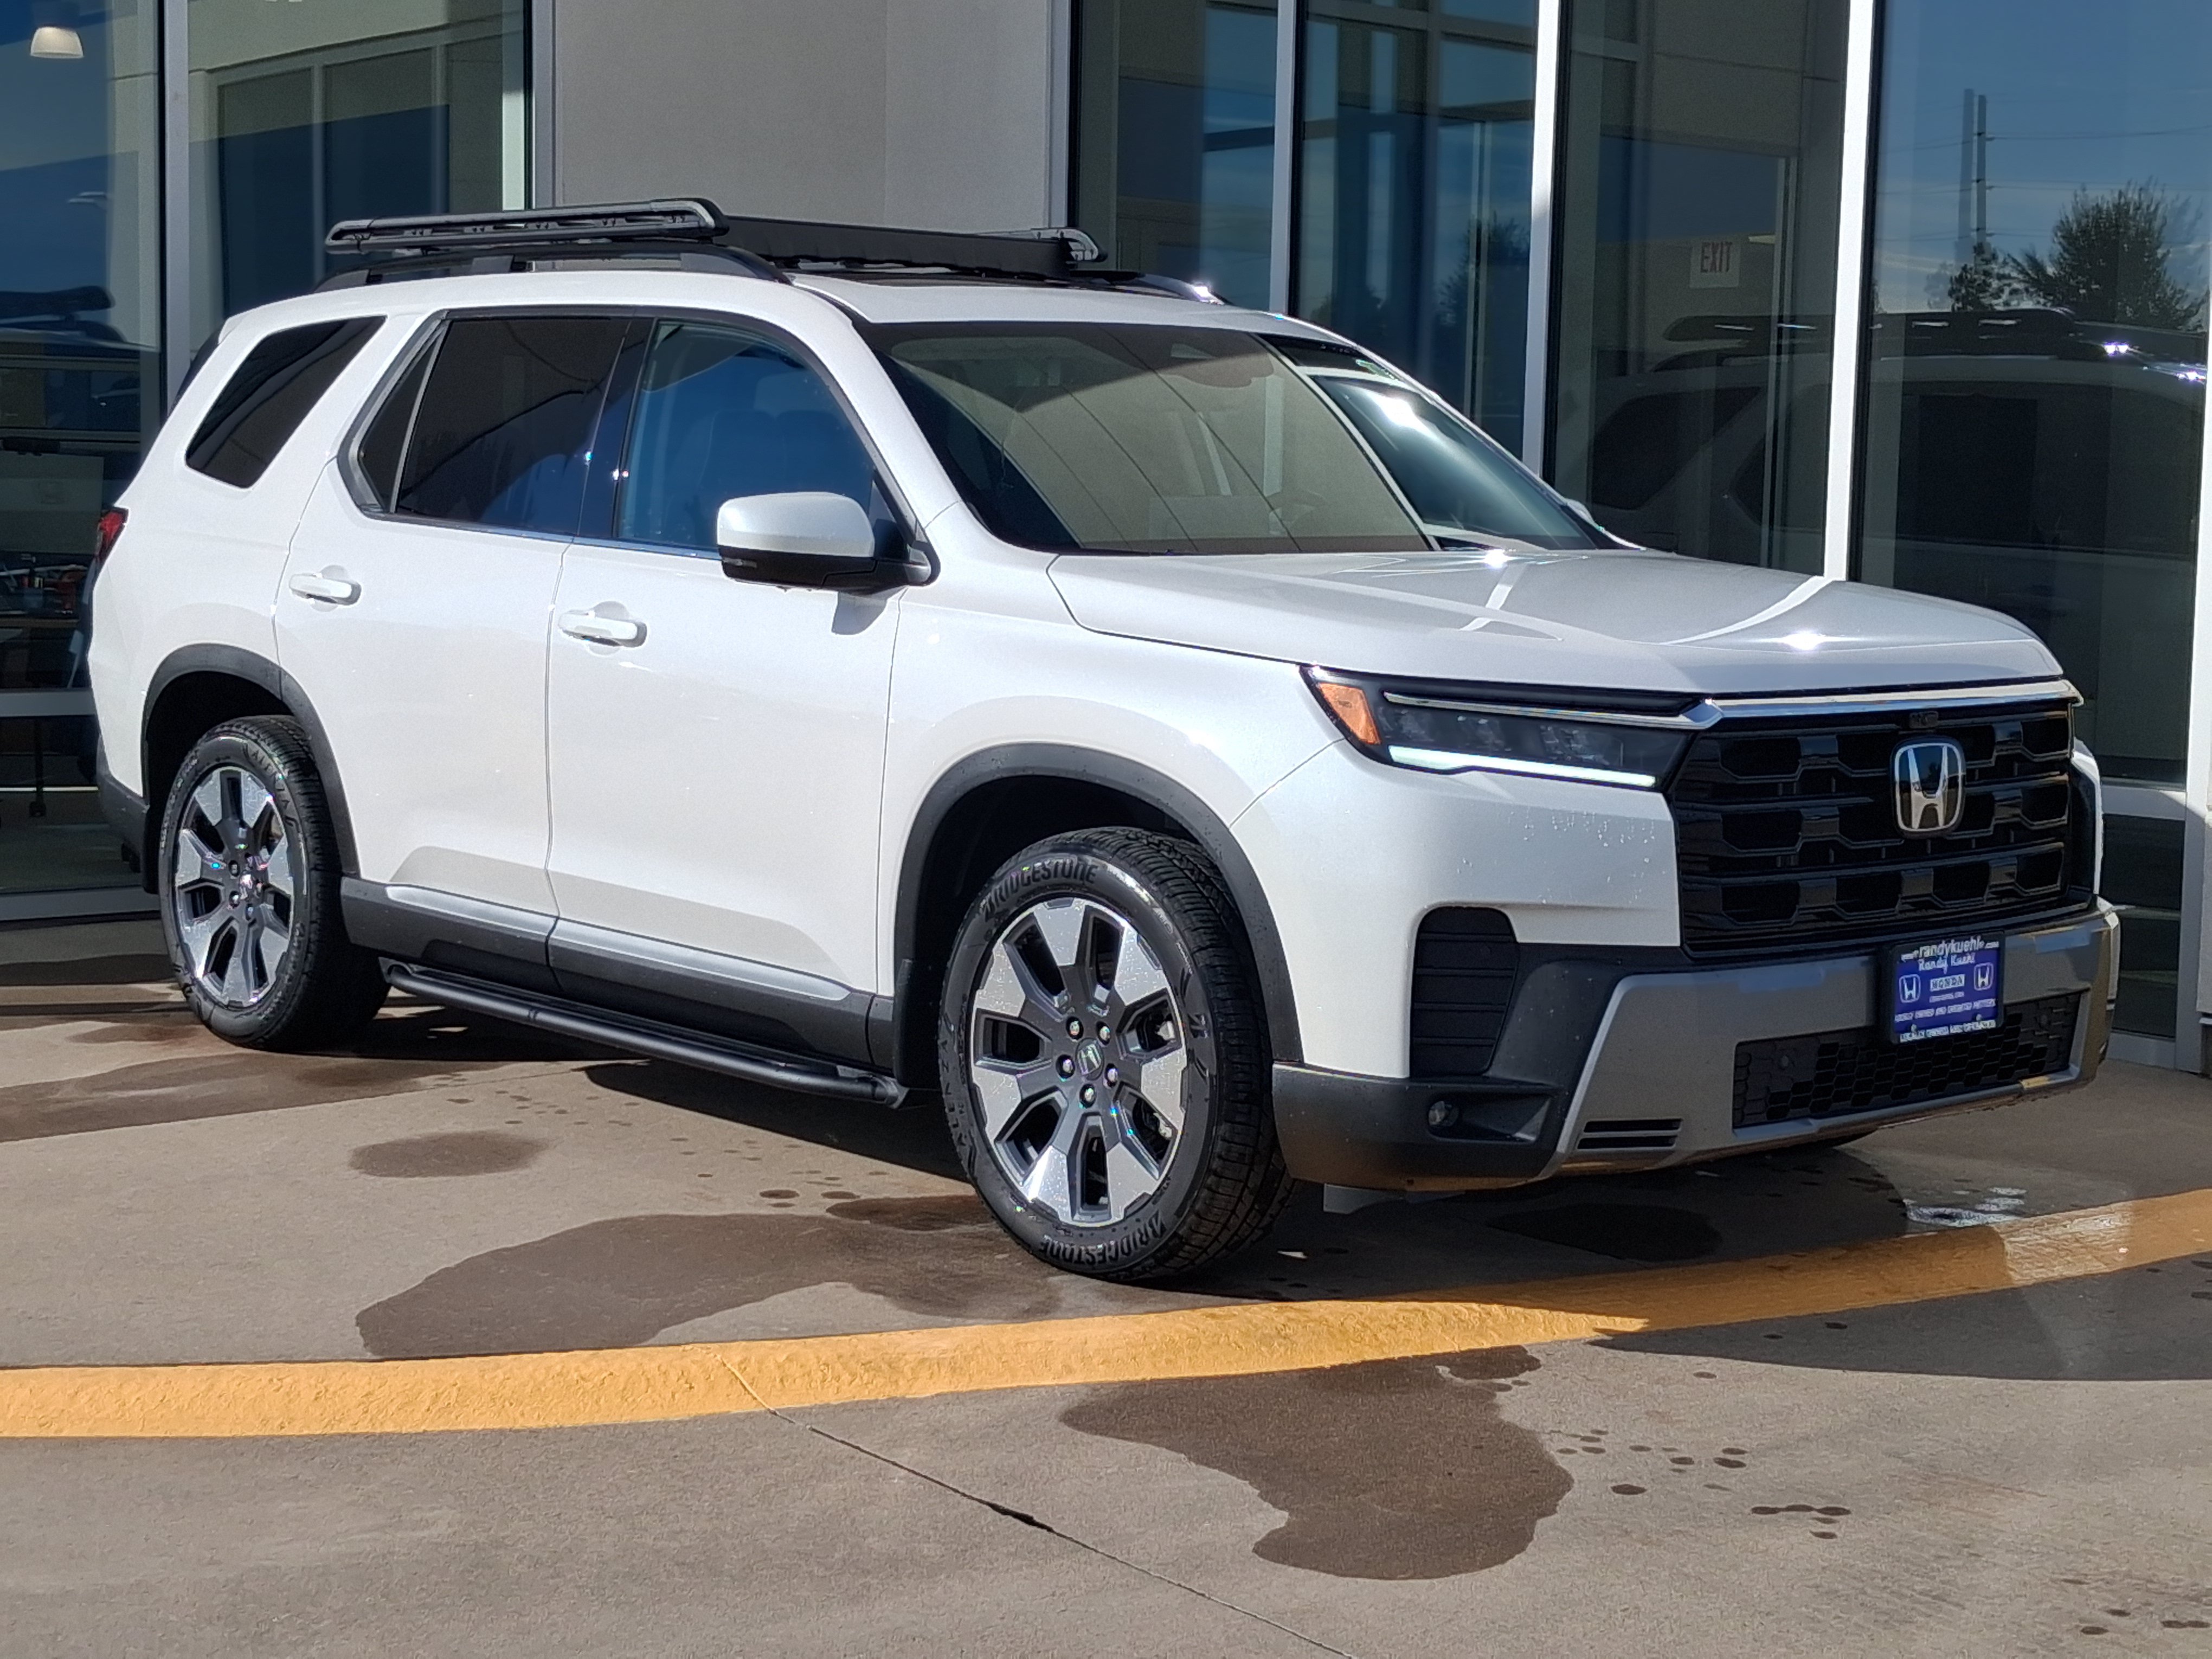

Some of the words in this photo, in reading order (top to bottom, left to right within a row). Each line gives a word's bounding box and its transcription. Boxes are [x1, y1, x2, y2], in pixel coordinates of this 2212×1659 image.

[1700, 241, 1733, 273] EXIT
[251, 750, 291, 810] ALEA
[980, 859, 1097, 921] BRIDGESTONE
[938, 1038, 967, 1147] ALENZA
[1039, 1212, 1166, 1266] BRIDGESTONE
